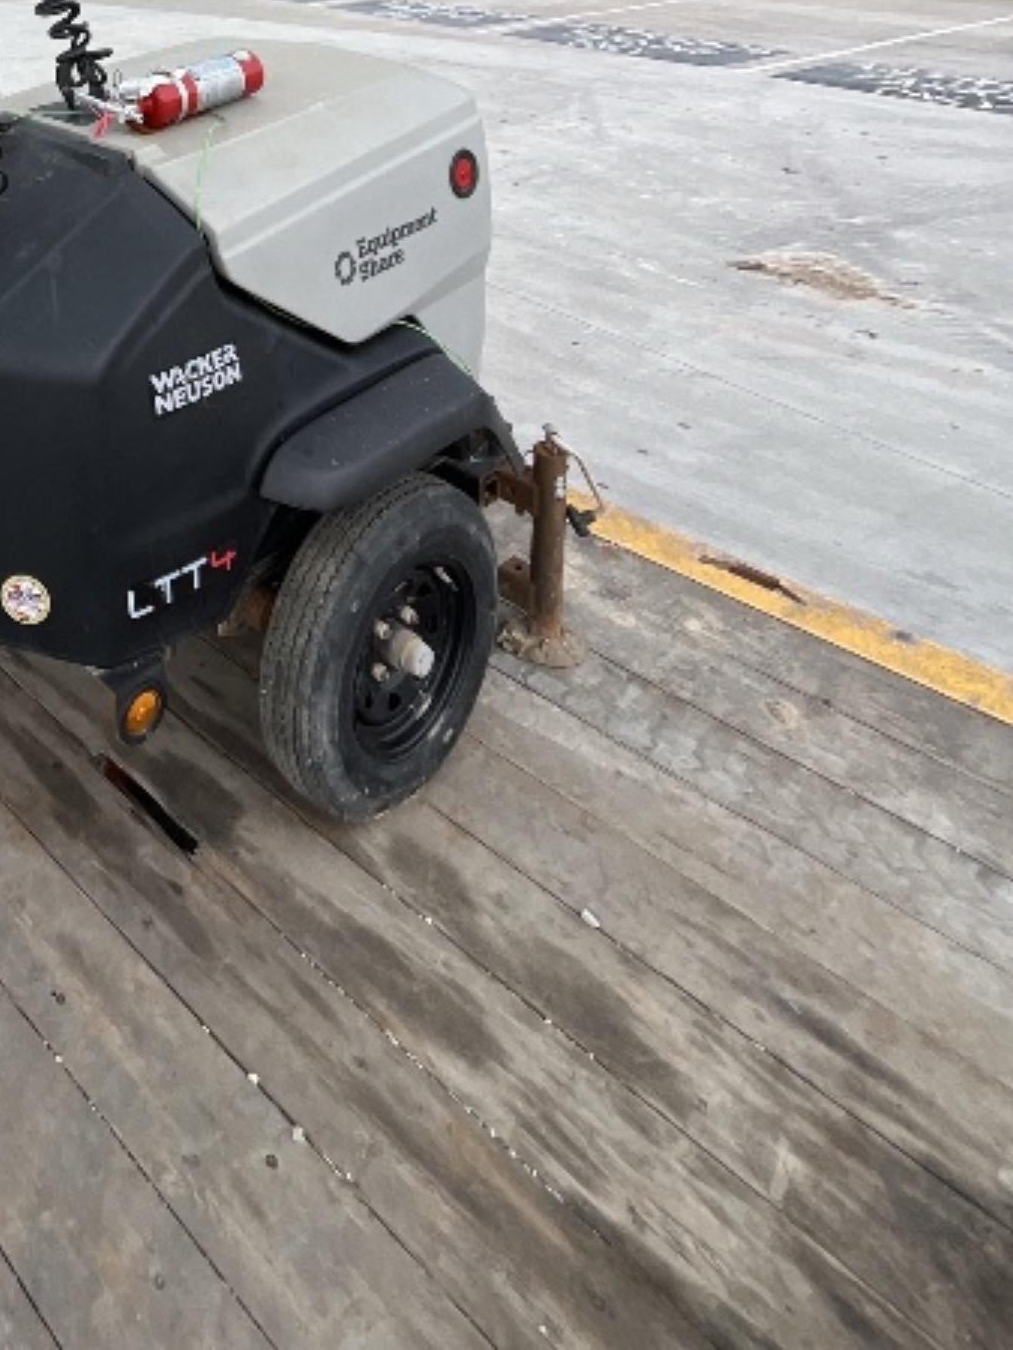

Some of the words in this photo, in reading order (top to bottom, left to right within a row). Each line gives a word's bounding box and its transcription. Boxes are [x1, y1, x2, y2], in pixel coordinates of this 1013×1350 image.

[355, 206, 438, 259] Equipment
[359, 249, 405, 282] Share
[149, 343, 240, 394] WACKER
[154, 361, 243, 416] NEUSON
